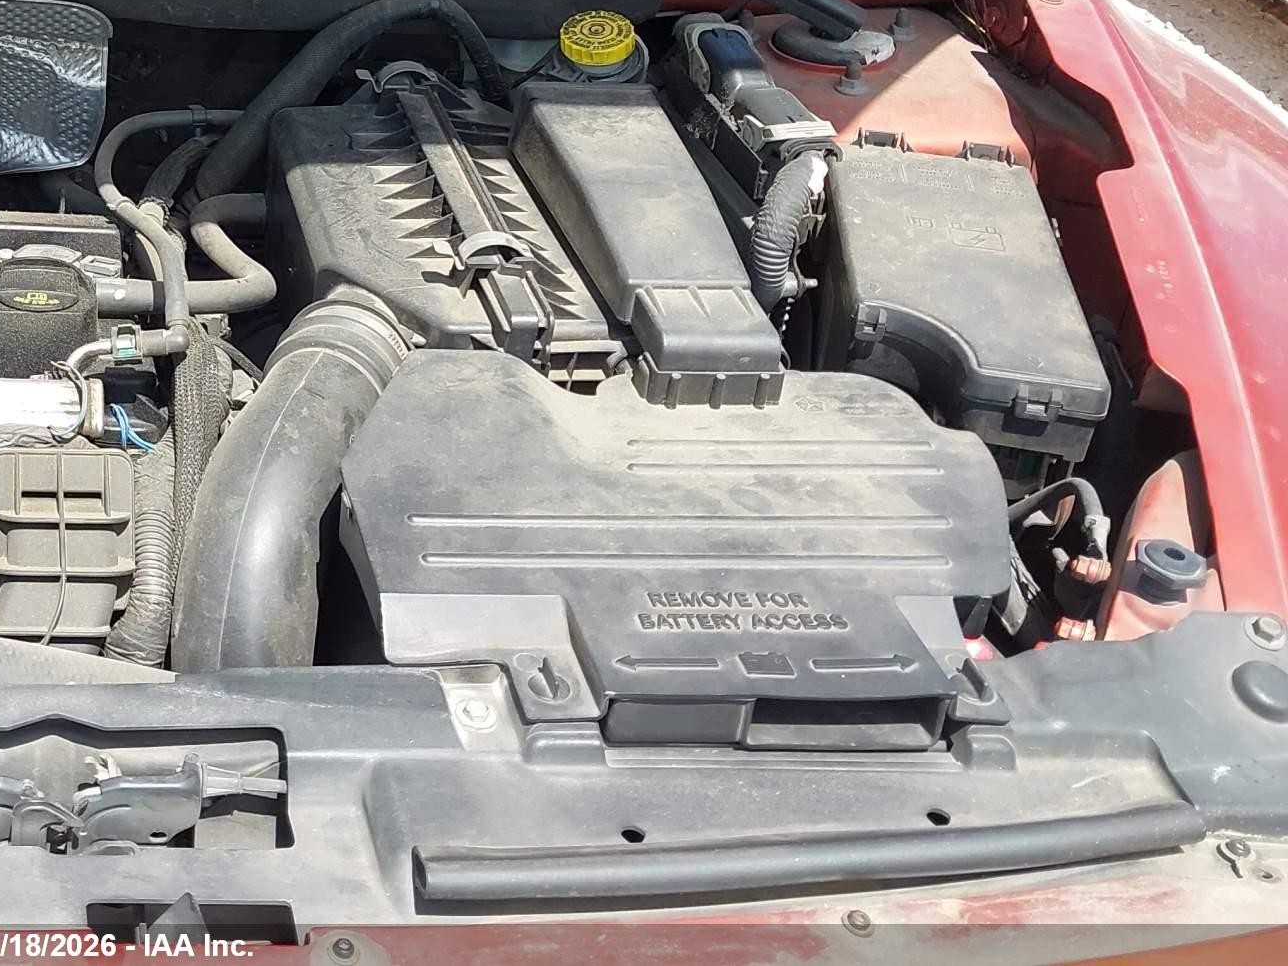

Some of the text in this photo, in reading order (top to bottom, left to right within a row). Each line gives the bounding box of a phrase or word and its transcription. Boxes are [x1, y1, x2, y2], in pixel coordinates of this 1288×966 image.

[645, 590, 809, 608] REMOVE FOR
[637, 612, 849, 631] BATTERY ACCESS
